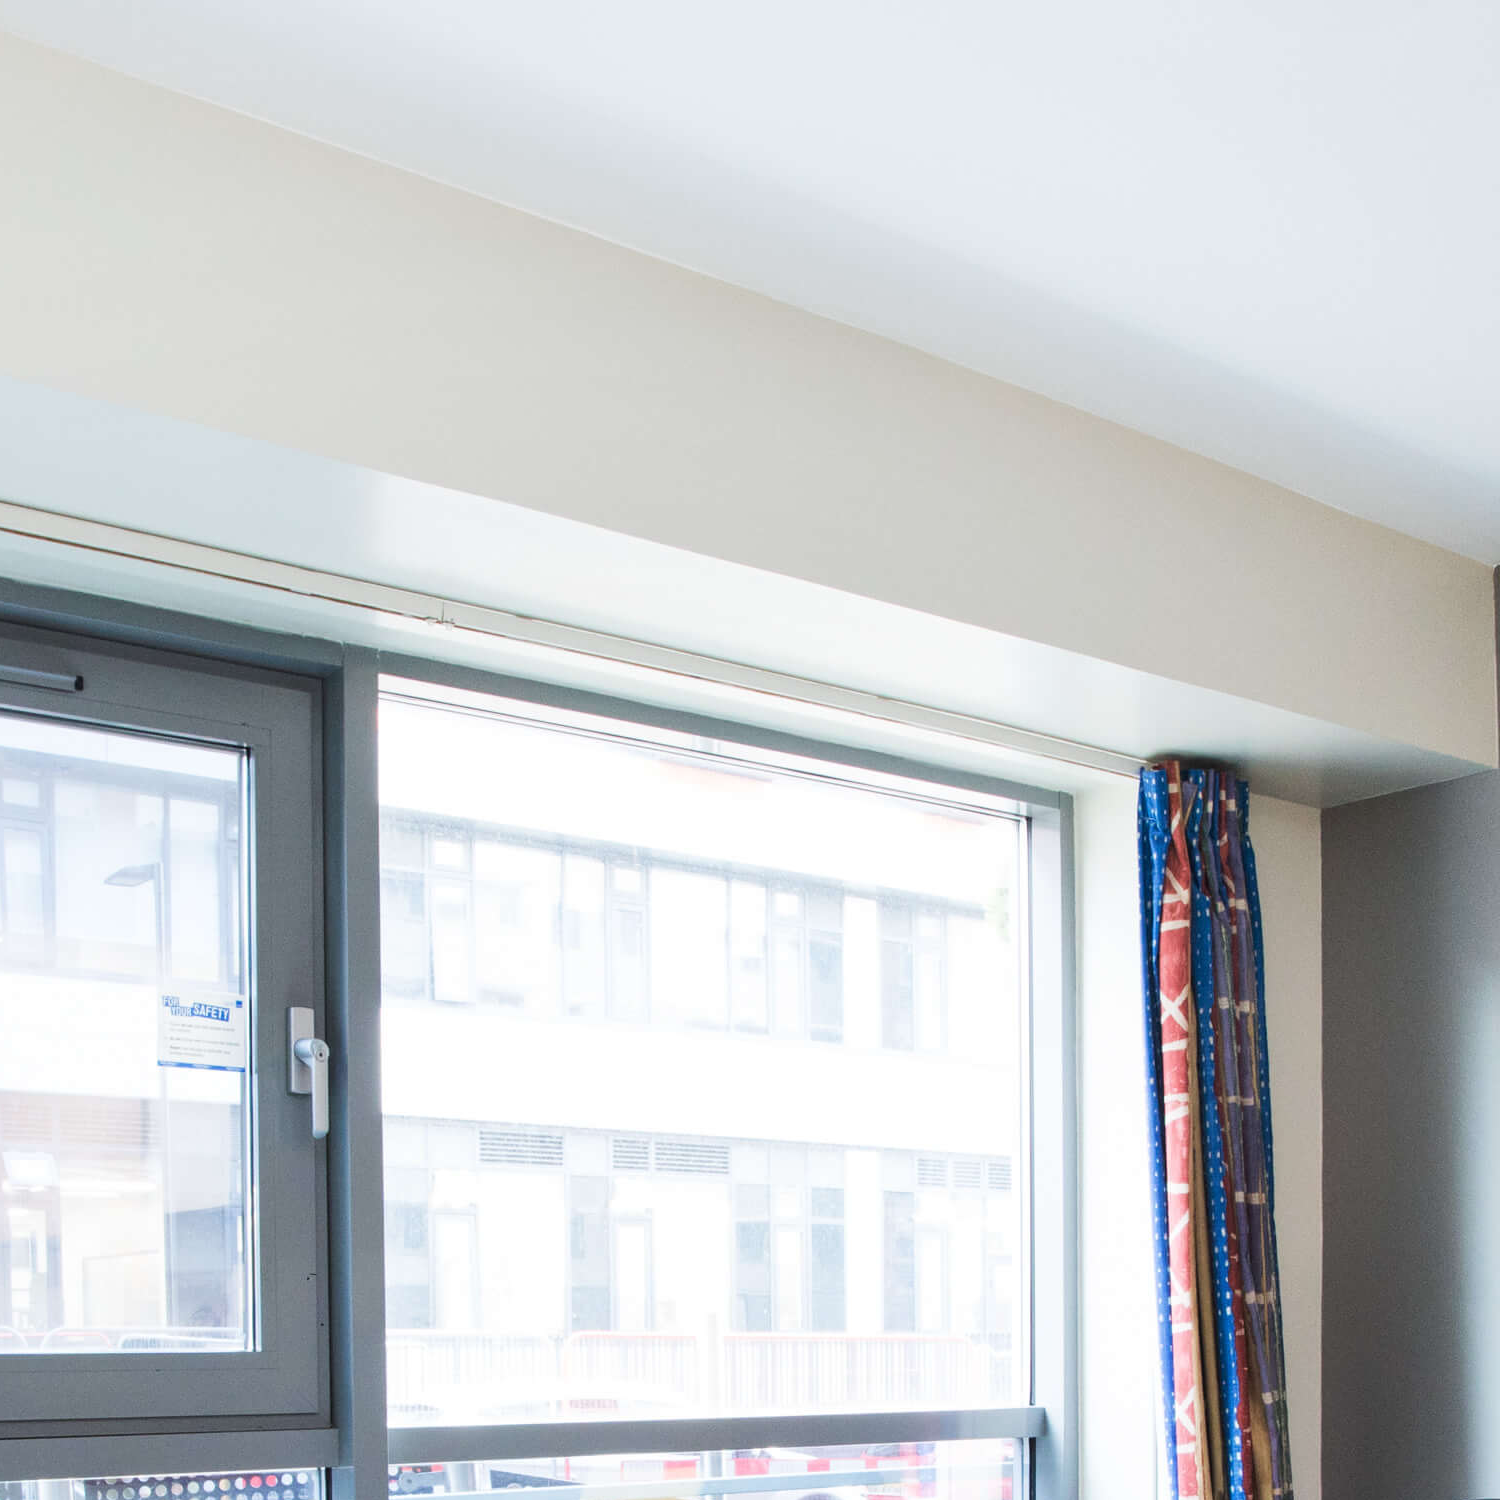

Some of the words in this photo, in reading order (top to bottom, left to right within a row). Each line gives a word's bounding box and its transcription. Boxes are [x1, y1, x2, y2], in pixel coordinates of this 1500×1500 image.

[163, 996, 180, 1007] FOR
[170, 1006, 192, 1017] YOUR
[193, 1003, 229, 1021] SAFETY
